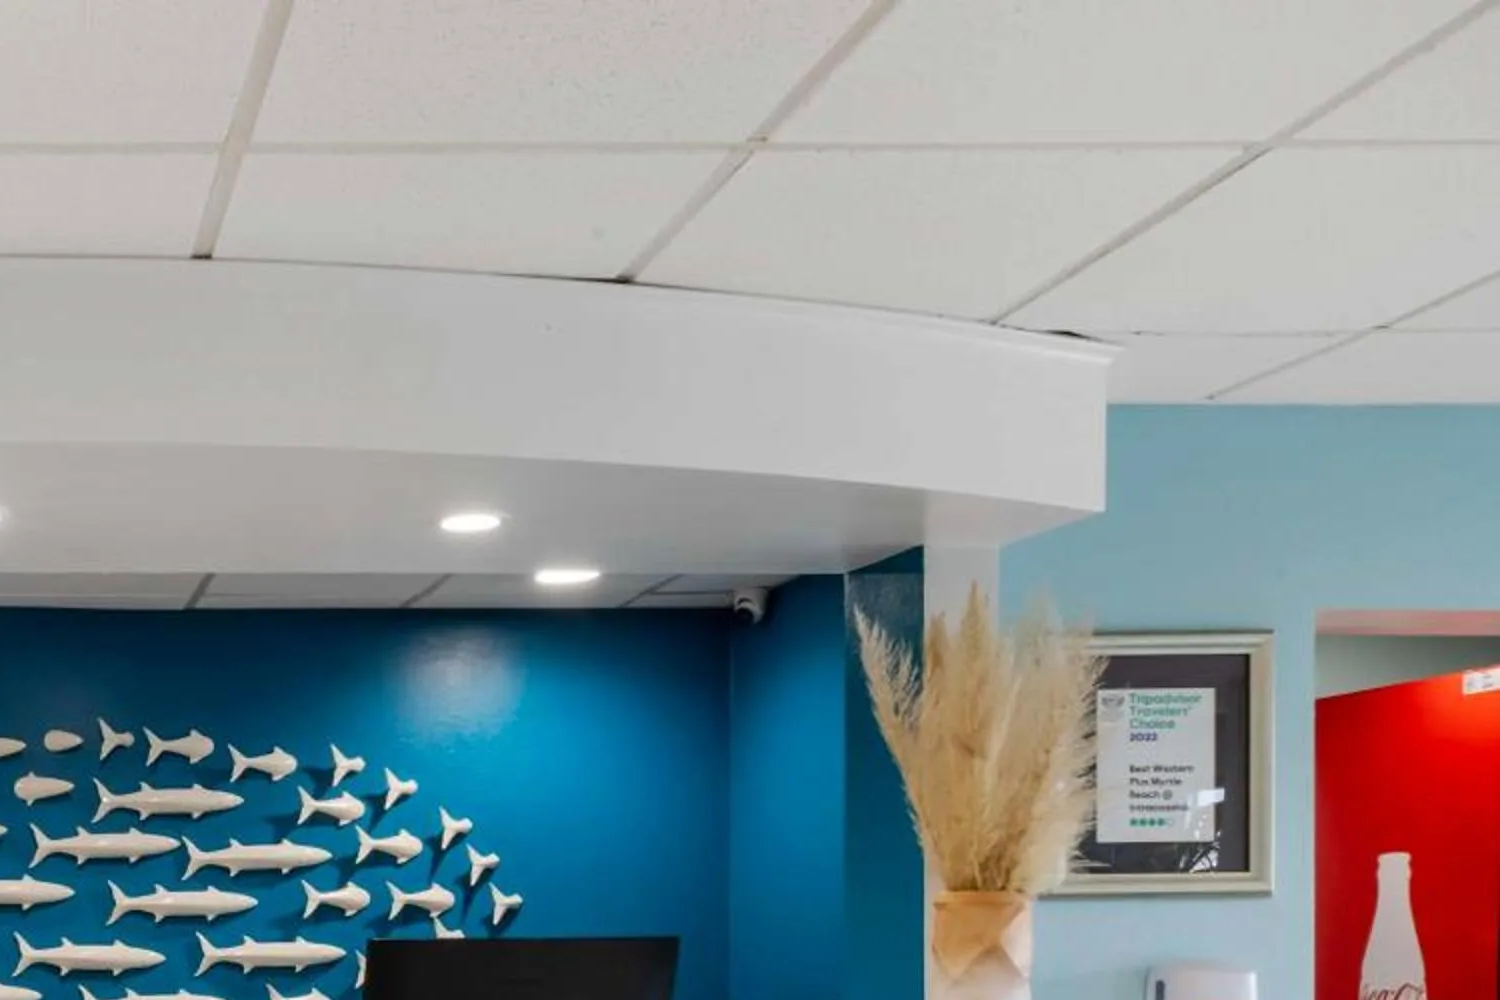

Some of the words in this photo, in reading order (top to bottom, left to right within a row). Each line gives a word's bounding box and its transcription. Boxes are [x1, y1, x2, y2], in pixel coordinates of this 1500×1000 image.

[1129, 692, 1203, 706] Tripadvisor
[1129, 718, 1176, 730] Choice
[1129, 732, 1158, 742] 2022
[1129, 764, 1150, 774] Best
[1152, 764, 1195, 774] Western
[1150, 777, 1183, 788] Myrtle
[1129, 789, 1160, 799] Beach
